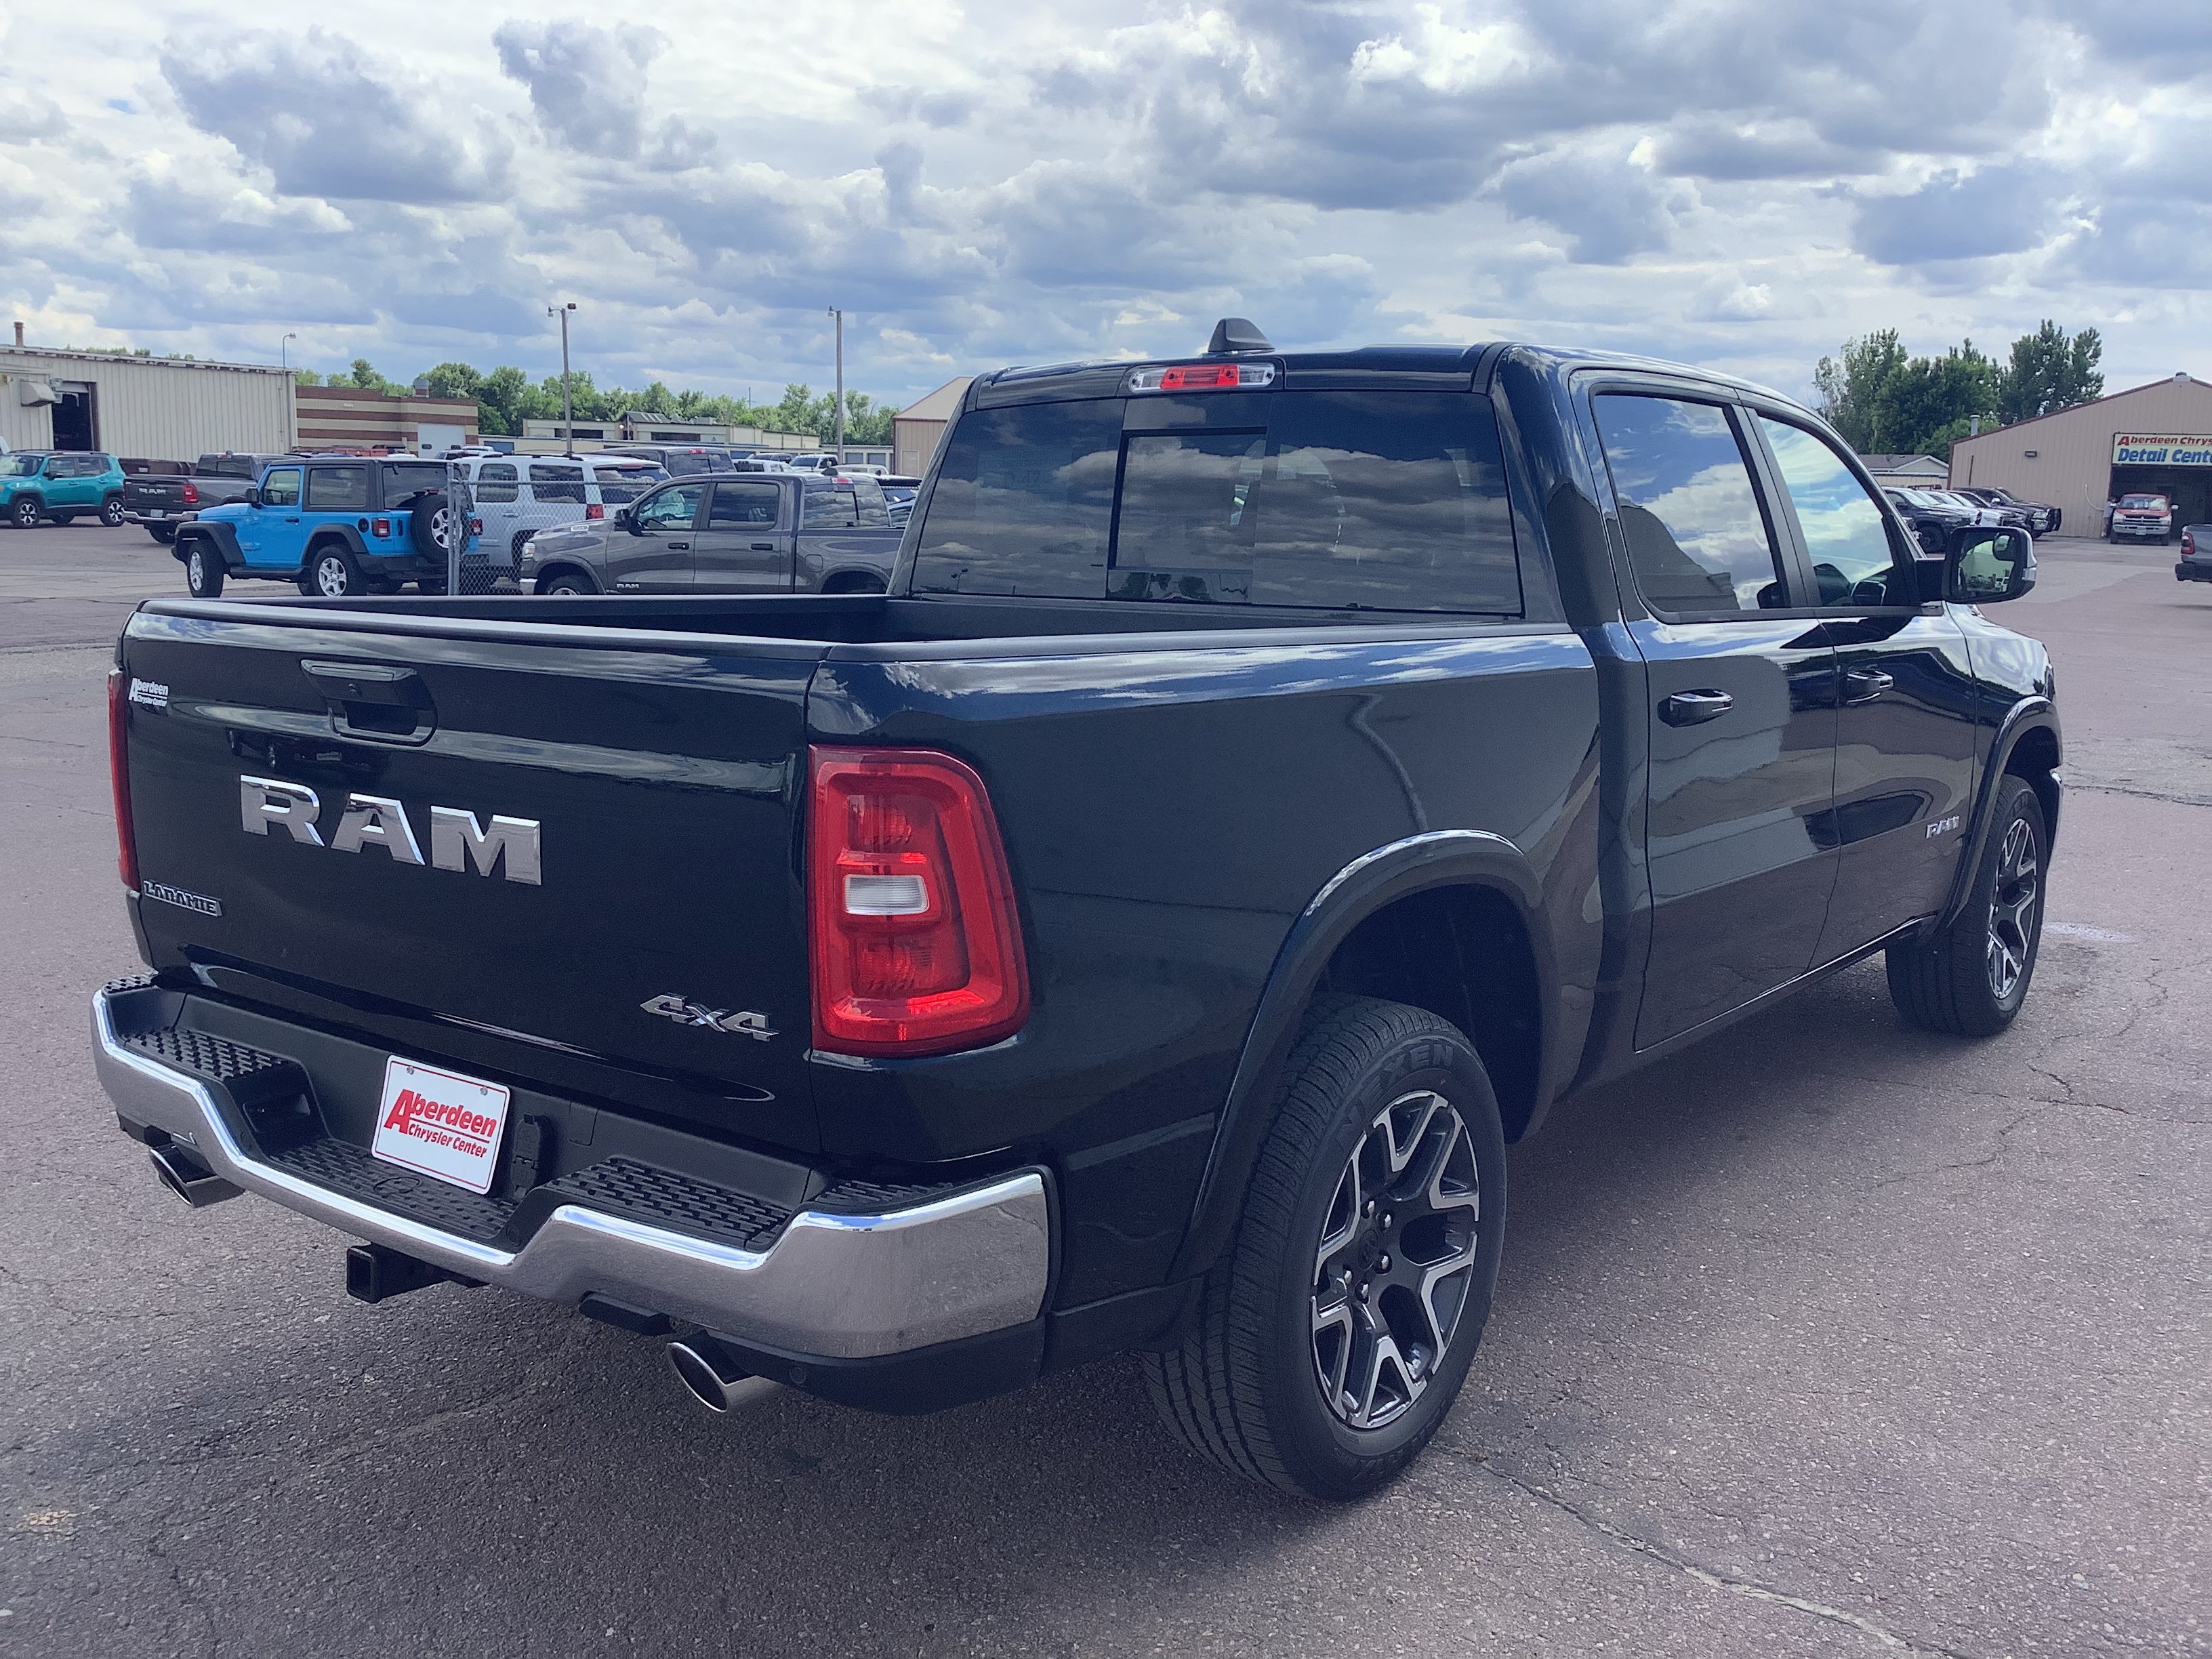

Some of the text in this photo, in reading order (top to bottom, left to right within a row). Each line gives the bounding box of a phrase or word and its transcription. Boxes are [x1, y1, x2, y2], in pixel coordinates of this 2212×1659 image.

[2117, 436, 2178, 446] Aberdeen
[2117, 448, 2212, 463] Detail Cent
[129, 678, 169, 702] Aberdeen
[241, 775, 541, 886] RAM
[1925, 815, 1960, 839] RAM
[143, 880, 222, 918] LARAMIE
[640, 994, 779, 1042] 4x4
[384, 1088, 497, 1138] Aberdeen
[408, 1123, 488, 1158] Chrysler Center
